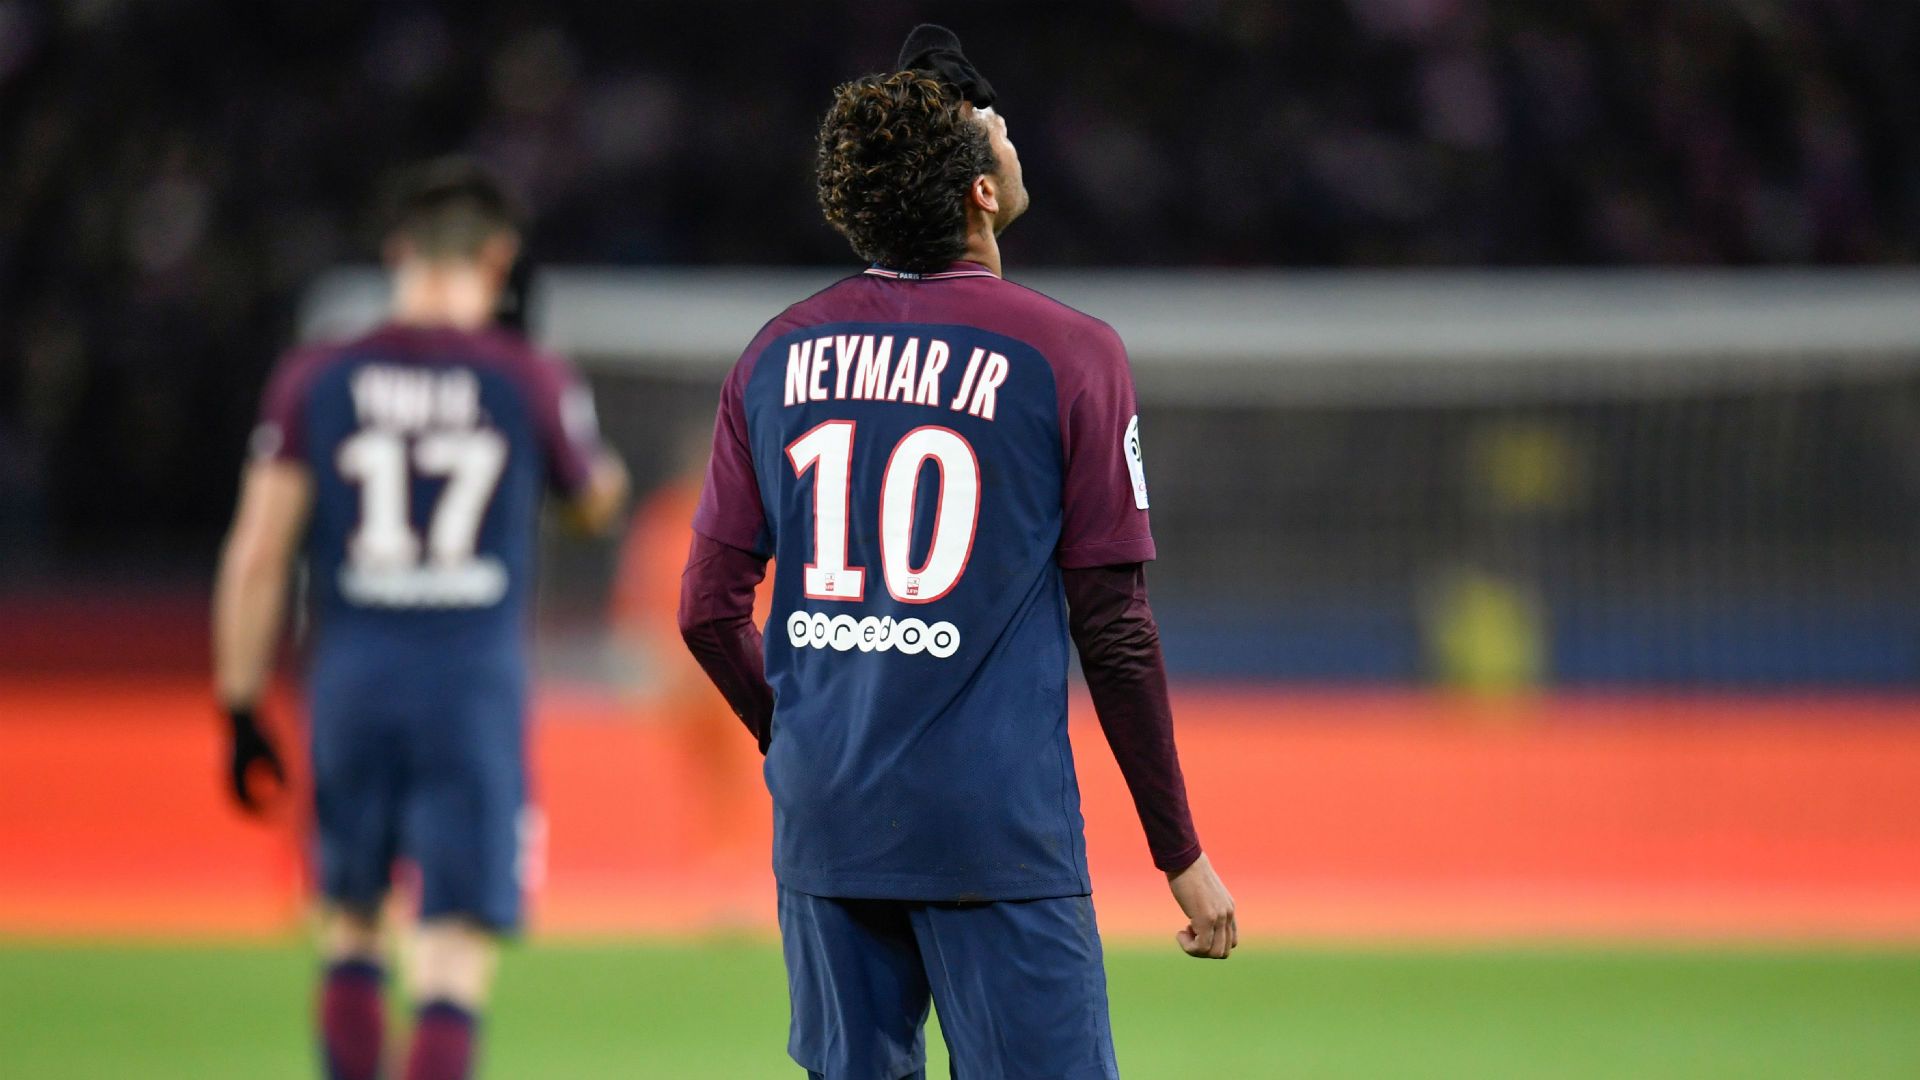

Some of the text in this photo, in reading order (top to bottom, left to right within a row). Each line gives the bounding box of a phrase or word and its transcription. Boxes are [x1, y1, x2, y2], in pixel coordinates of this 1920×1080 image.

[900, 272, 919, 280] PARIS
[784, 335, 1009, 421] NEYMAR JR
[337, 430, 509, 564] 17
[785, 419, 981, 604] 10
[790, 613, 957, 653] ooredoo
